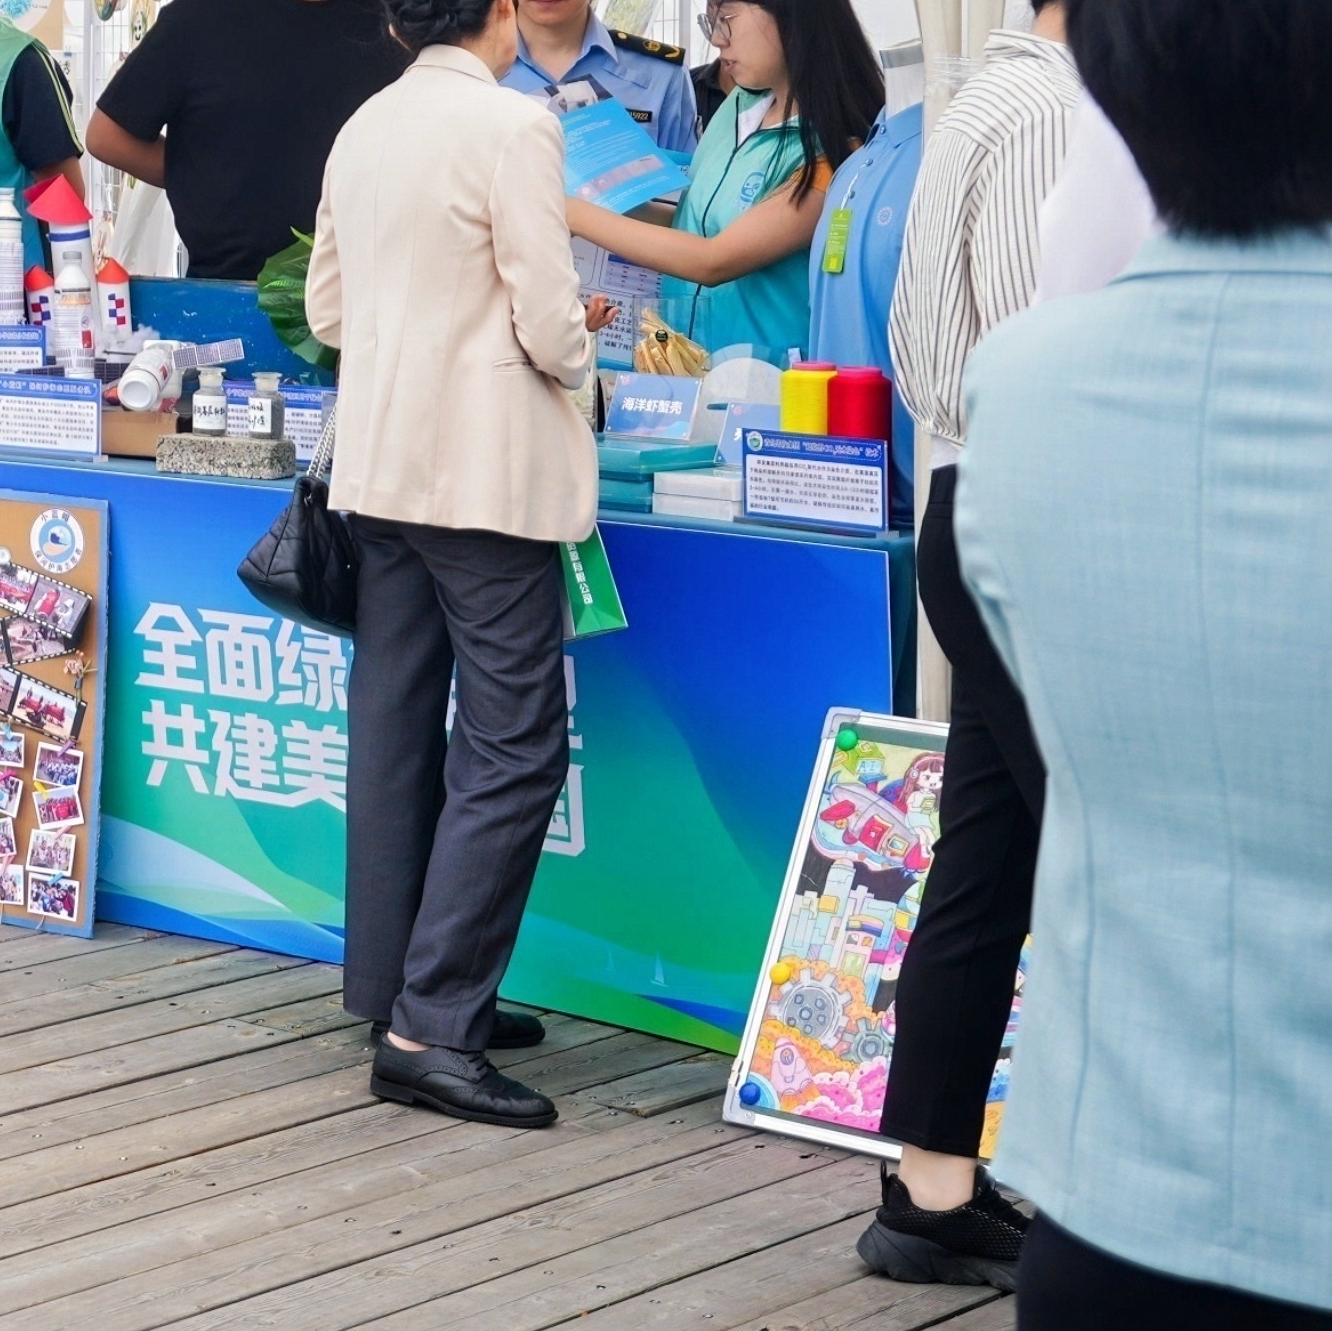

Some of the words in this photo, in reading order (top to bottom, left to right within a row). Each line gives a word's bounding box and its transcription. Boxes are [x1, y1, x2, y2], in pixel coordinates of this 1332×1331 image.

[621, 396, 684, 415] 海洋虾蟹壳
